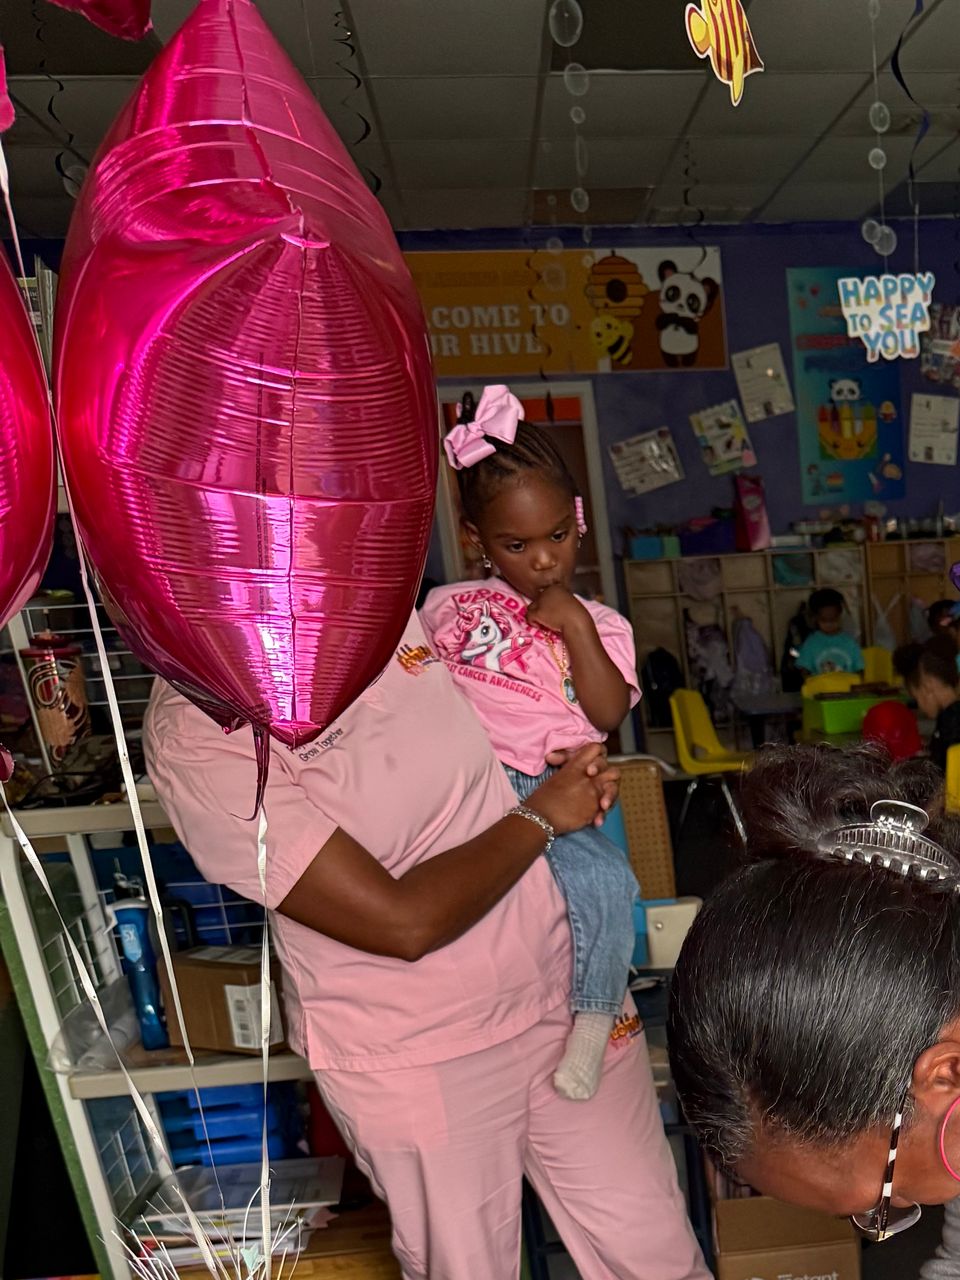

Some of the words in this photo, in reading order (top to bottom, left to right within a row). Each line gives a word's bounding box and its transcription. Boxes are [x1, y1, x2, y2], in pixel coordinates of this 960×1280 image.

[841, 273, 934, 307] HAPPY
[430, 303, 521, 329] COME
[528, 302, 570, 327] TO
[848, 313, 873, 332] TO
[878, 301, 928, 331] SEA
[470, 331, 544, 356] HIVE
[863, 329, 918, 360] YOU
[458, 665, 488, 683] CANCER
[489, 675, 544, 703] AWARENESS
[298, 747, 320, 762] Grow
